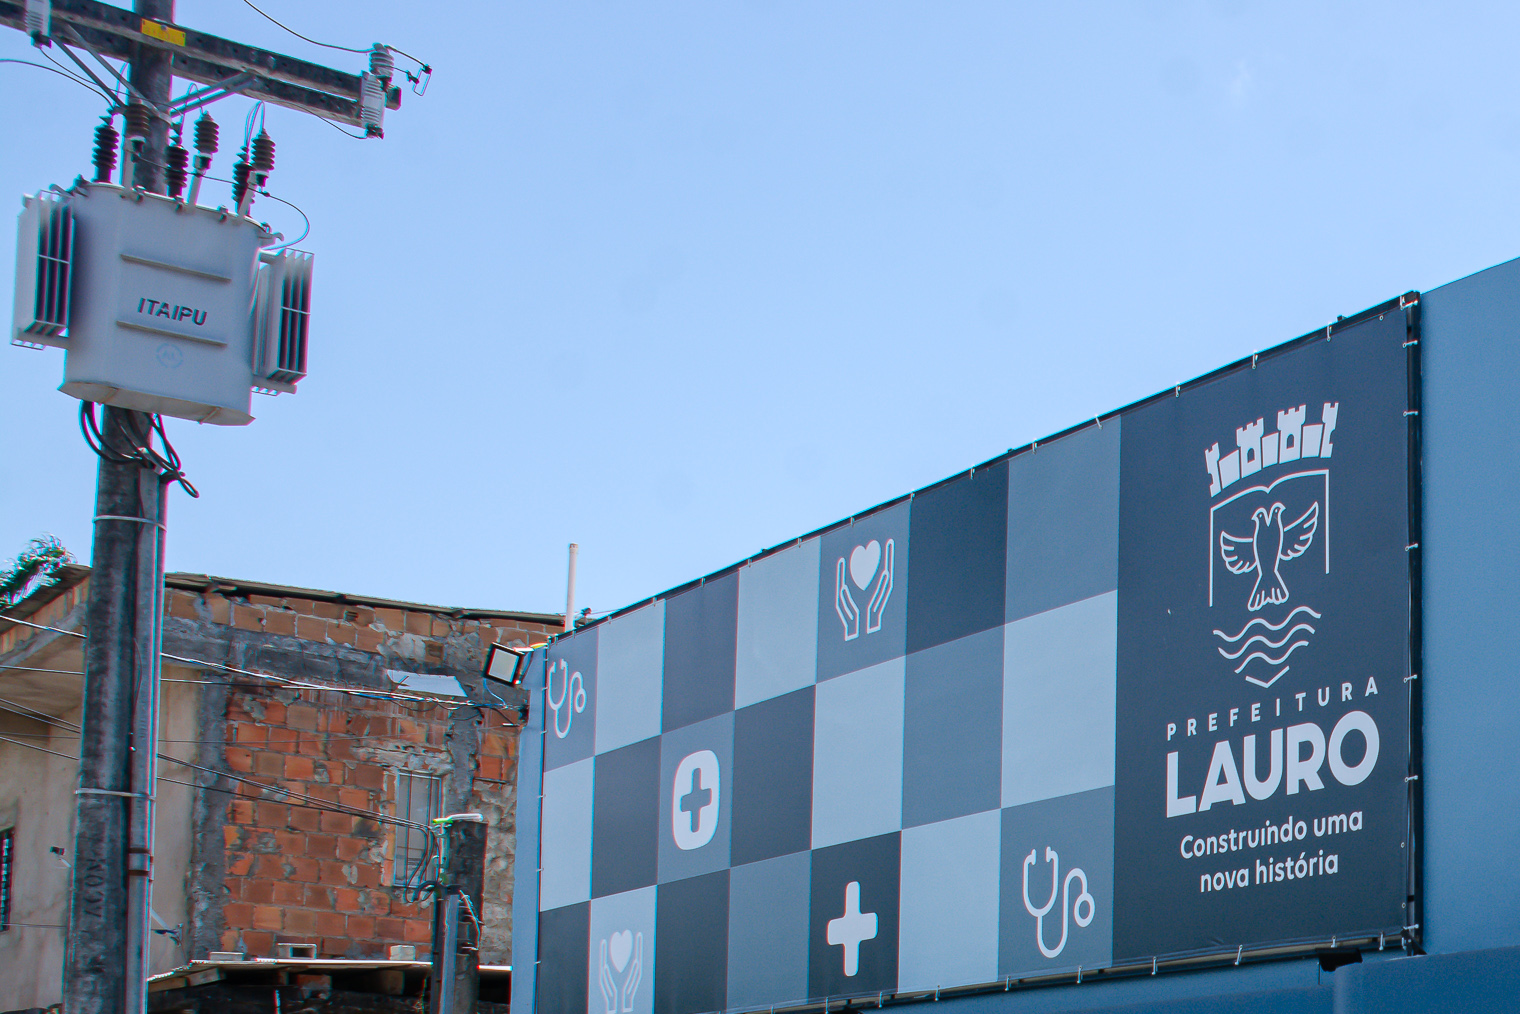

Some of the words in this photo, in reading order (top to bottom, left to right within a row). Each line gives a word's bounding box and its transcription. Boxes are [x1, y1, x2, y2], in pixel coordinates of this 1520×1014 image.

[138, 297, 208, 326] ITAIPU
[1166, 676, 1379, 741] PREFEITURA
[1166, 710, 1380, 818] LAURO
[1180, 815, 1308, 859] Construindo
[1313, 810, 1364, 837] uma
[1200, 867, 1249, 893] nova
[1255, 849, 1339, 885] história
